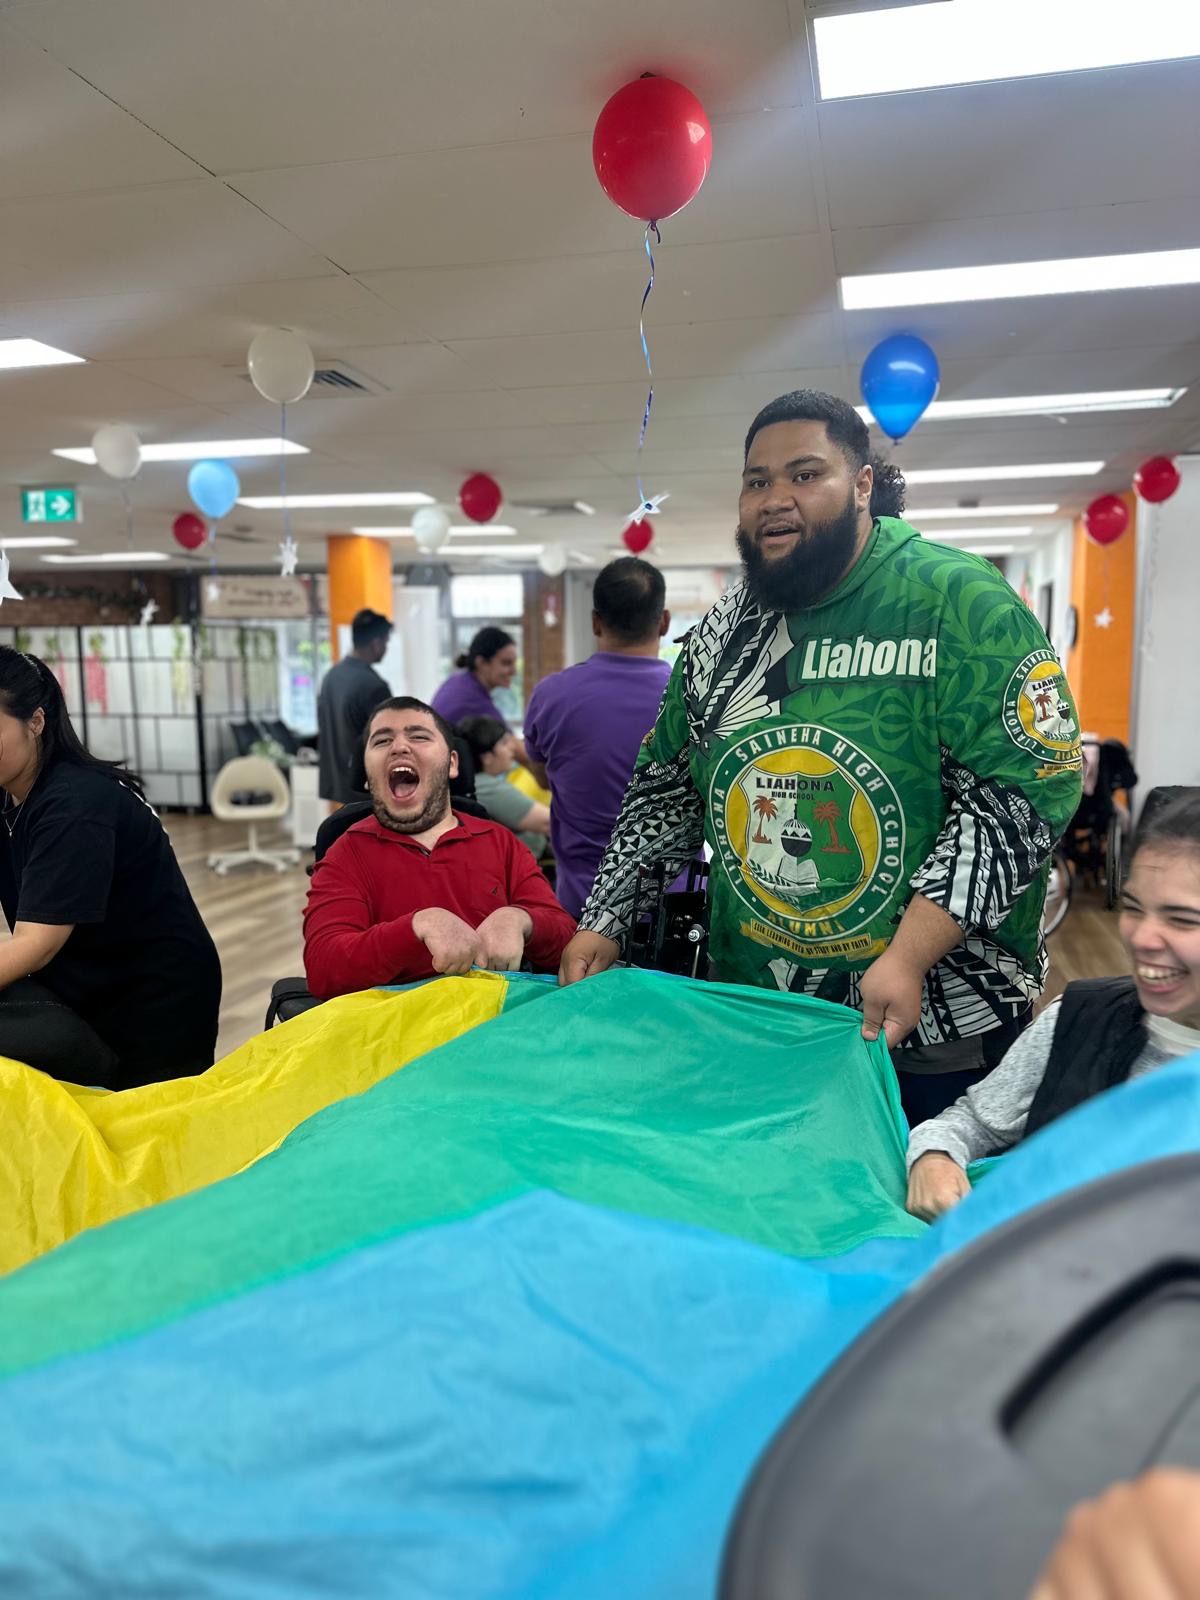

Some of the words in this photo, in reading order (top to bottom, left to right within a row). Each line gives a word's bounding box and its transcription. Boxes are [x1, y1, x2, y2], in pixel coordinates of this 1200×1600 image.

[802, 635, 937, 679] Liahona
[1006, 700, 1037, 749] LIAHONA
[756, 777, 835, 792] LIAHONA
[771, 791, 786, 799] HIGH
[788, 792, 814, 800] SCHOOL
[734, 727, 821, 762] SAINEHA
[831, 740, 885, 792] HIGH
[871, 803, 900, 896] SCHOOL
[713, 787, 743, 886] LIAHONA
[767, 911, 845, 936] ALUMNI
